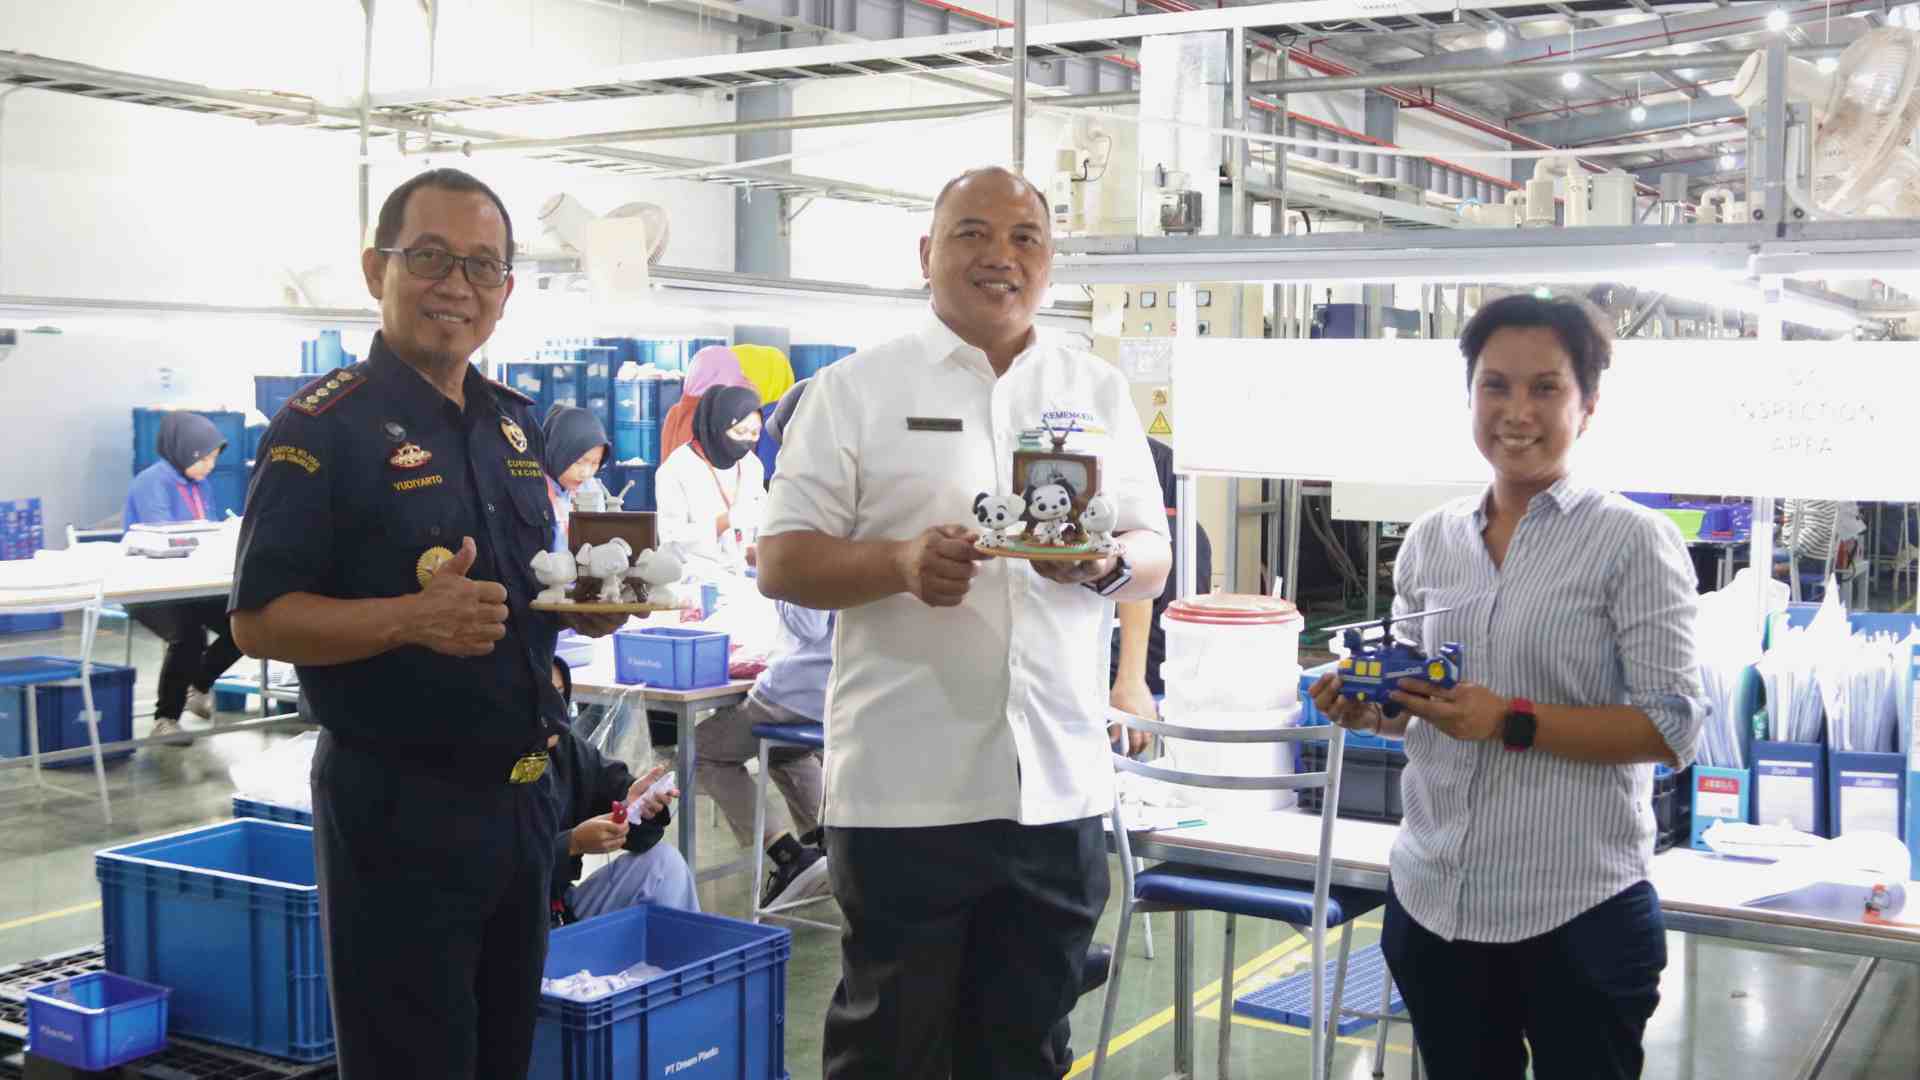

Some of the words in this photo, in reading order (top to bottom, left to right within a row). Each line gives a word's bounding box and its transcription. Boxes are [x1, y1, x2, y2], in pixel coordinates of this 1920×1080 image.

[1729, 399, 1881, 424] INSPECTION
[1769, 432, 1833, 456] AREA
[392, 474, 444, 491] YUDIYARTO
